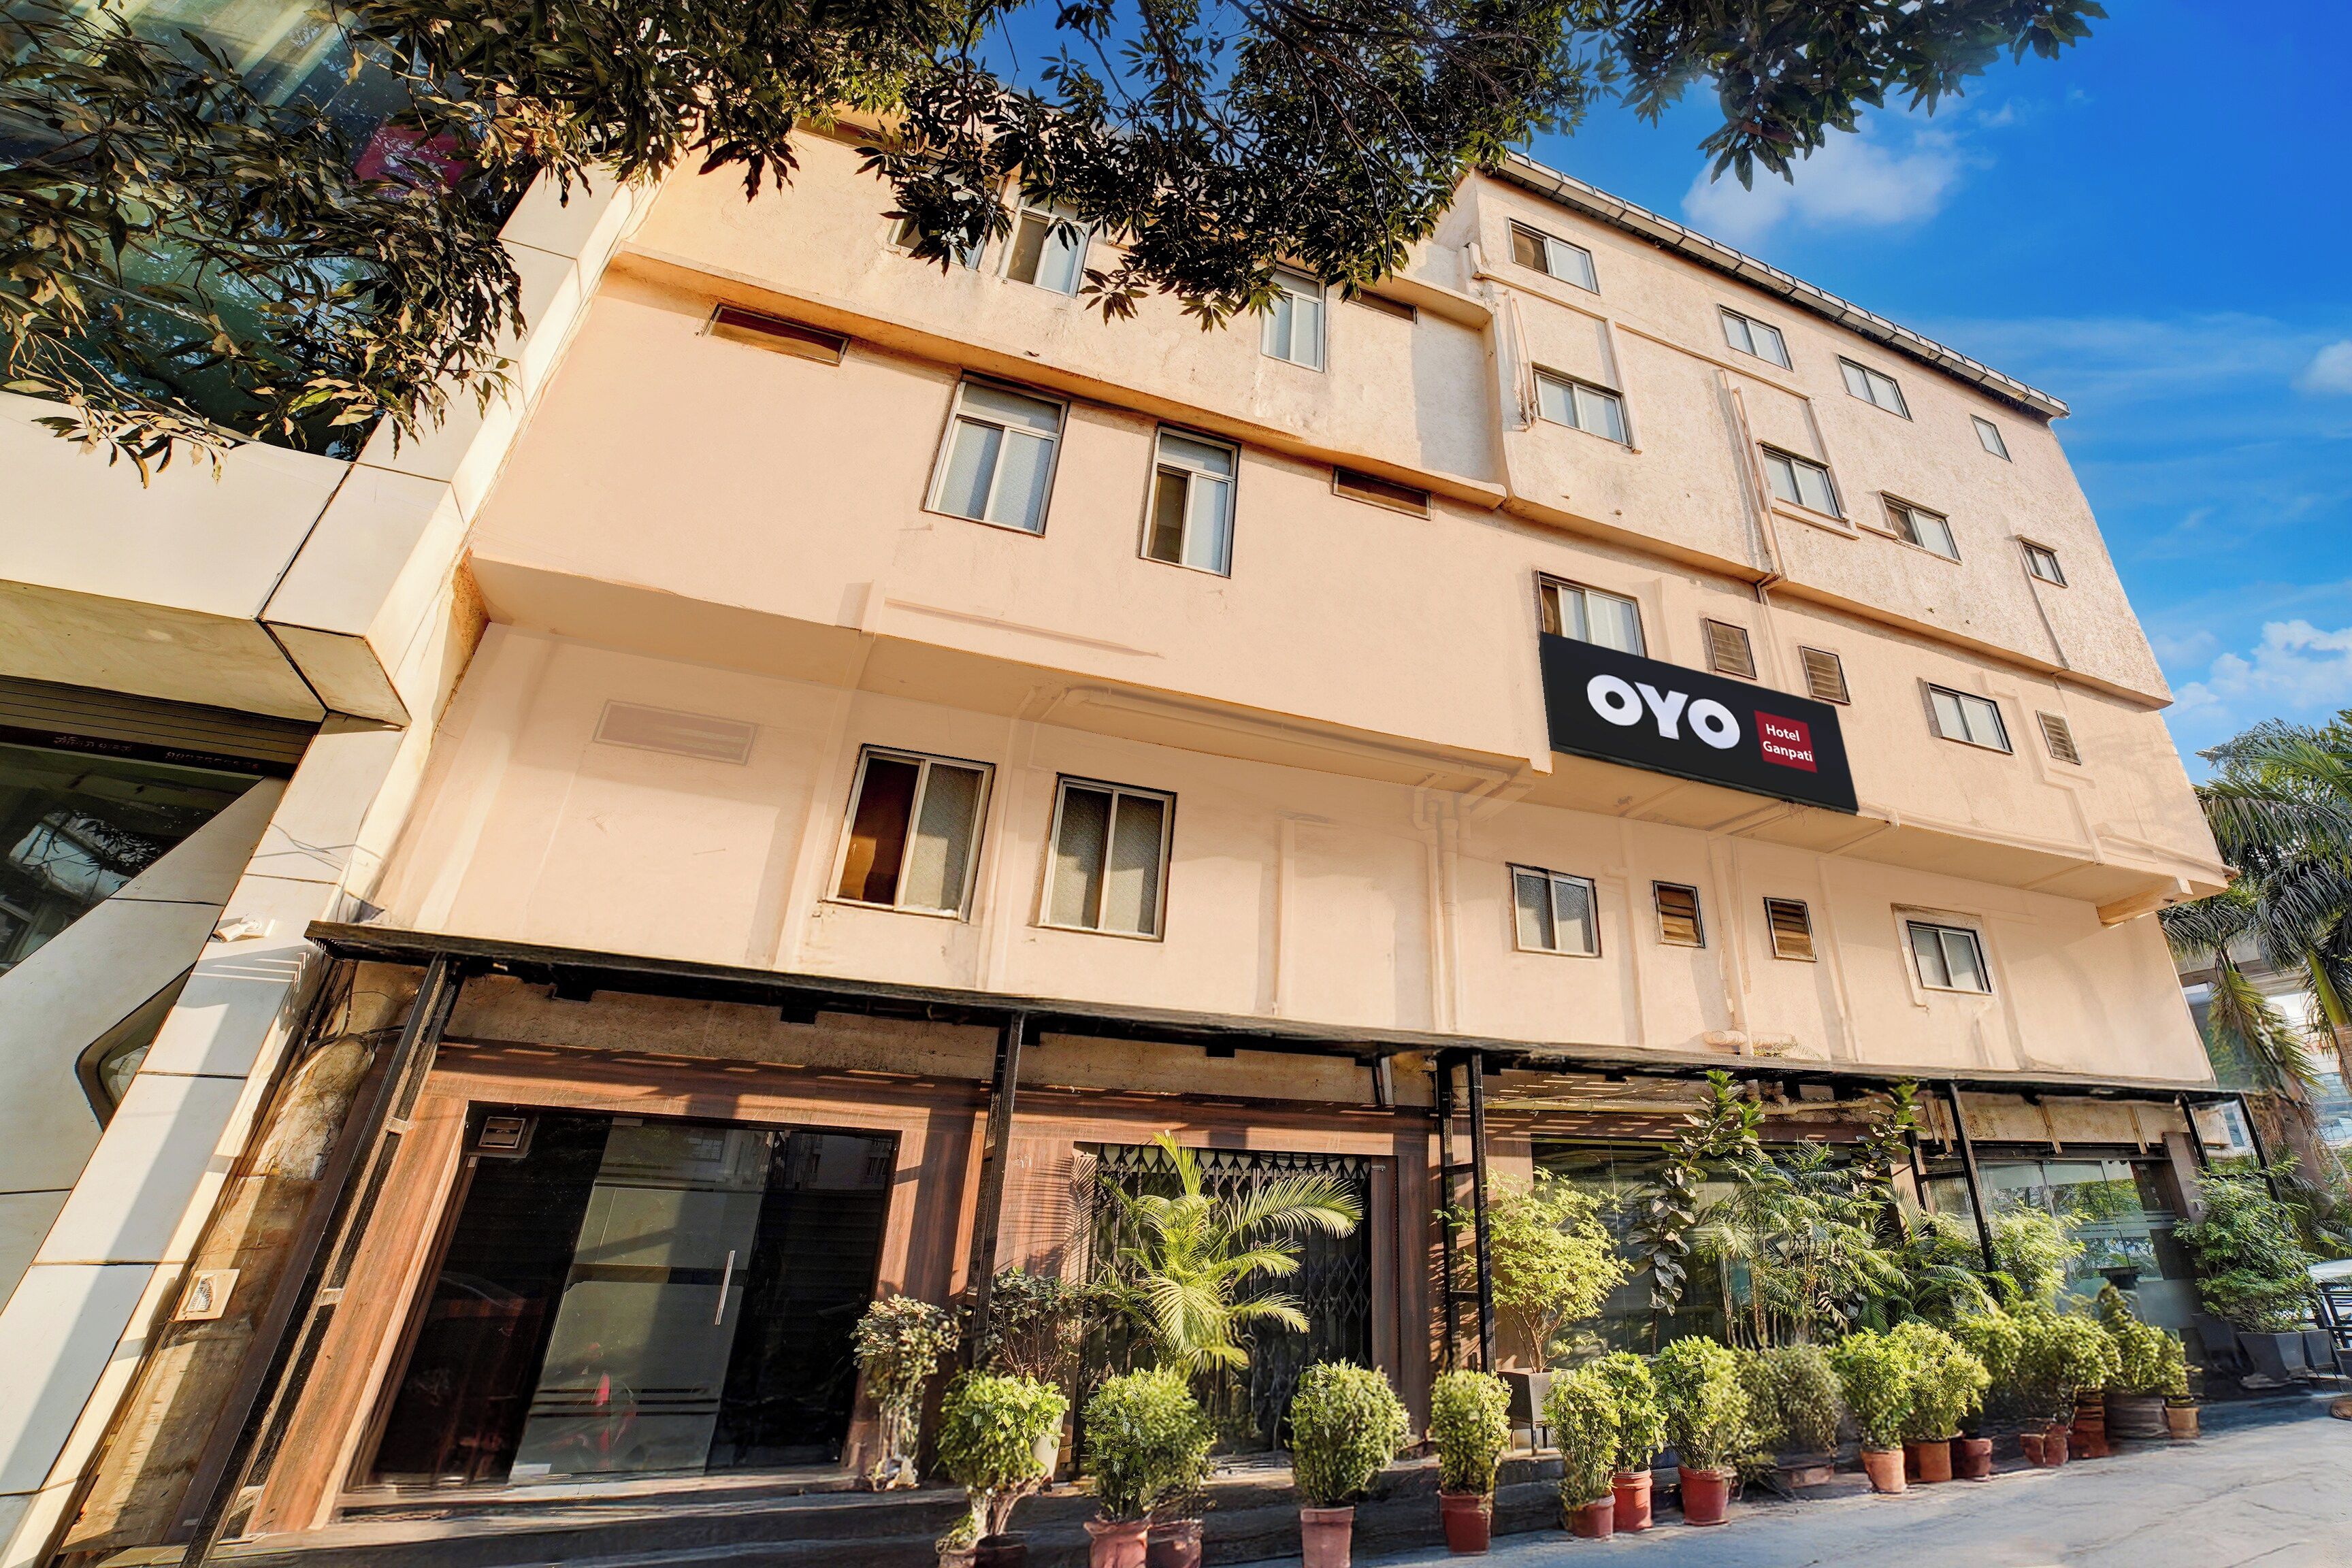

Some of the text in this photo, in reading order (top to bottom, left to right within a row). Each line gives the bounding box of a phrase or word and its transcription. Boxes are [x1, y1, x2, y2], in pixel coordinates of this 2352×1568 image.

[1586, 674, 1740, 749] OYO
[1765, 723, 1801, 742] Hotel
[1763, 740, 1814, 762] Ganpati
